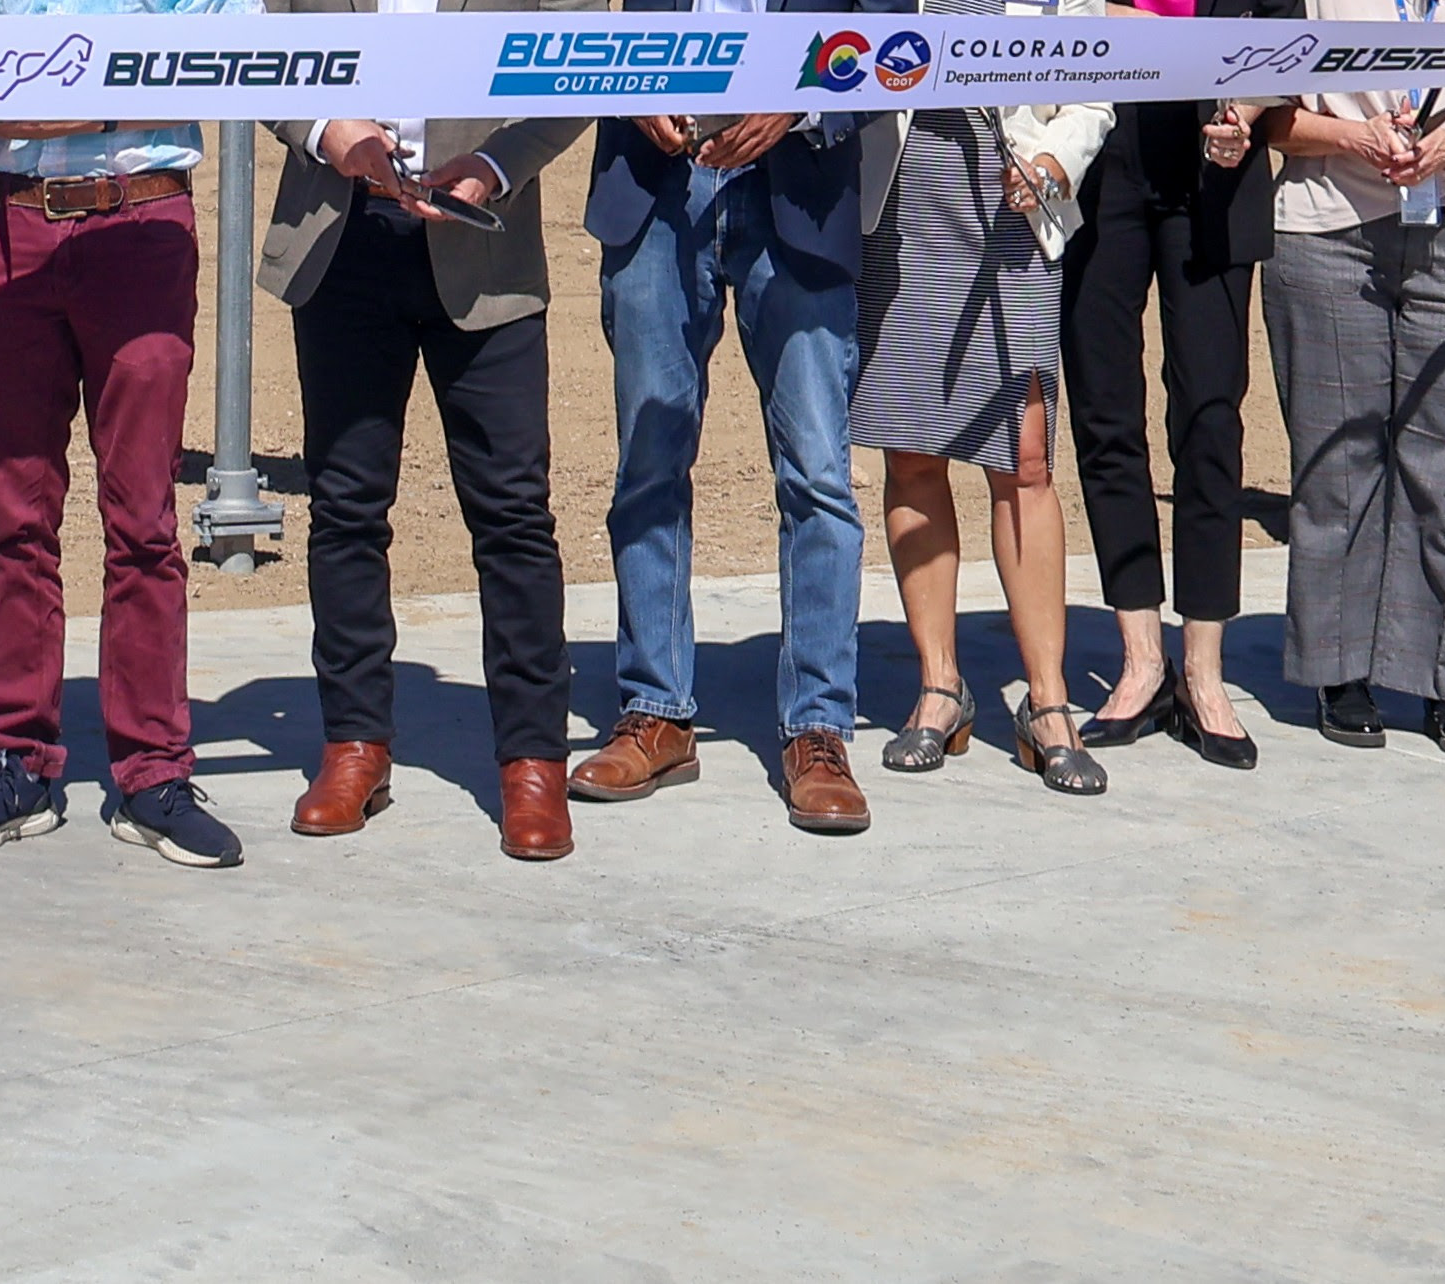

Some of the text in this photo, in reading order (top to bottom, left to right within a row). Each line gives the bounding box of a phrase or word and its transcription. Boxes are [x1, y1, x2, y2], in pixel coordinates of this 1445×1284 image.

[951, 39, 1110, 58] COLORADO
[554, 75, 669, 92] OUTRIDER
[885, 76, 914, 87] CDOT
[944, 68, 1161, 85] Department of Transportation
